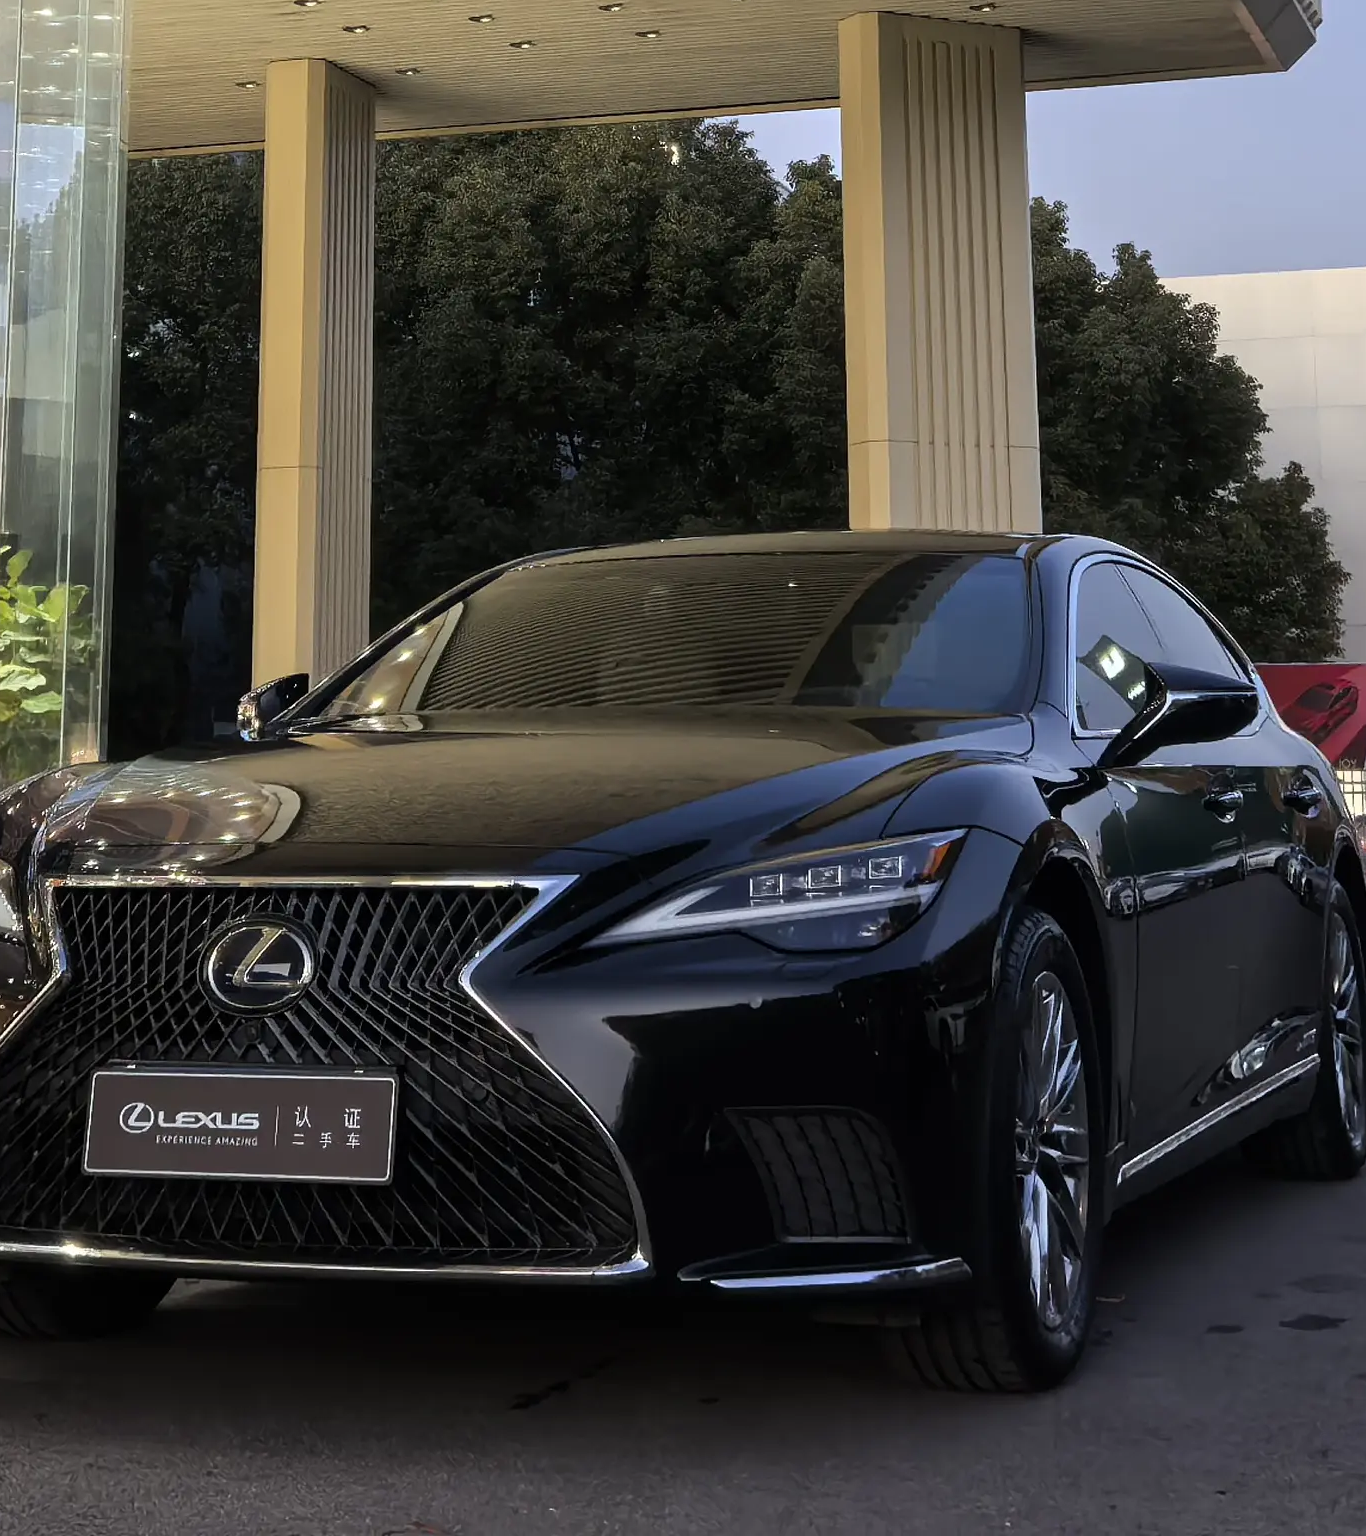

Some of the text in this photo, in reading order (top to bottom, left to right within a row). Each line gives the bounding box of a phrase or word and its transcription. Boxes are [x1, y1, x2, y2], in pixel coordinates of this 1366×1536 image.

[158, 1110, 260, 1130] LEXUS
[295, 1105, 361, 1129] 认证
[155, 1134, 259, 1147] EXPERIENCE AMAZING
[292, 1132, 362, 1149] 二手车
